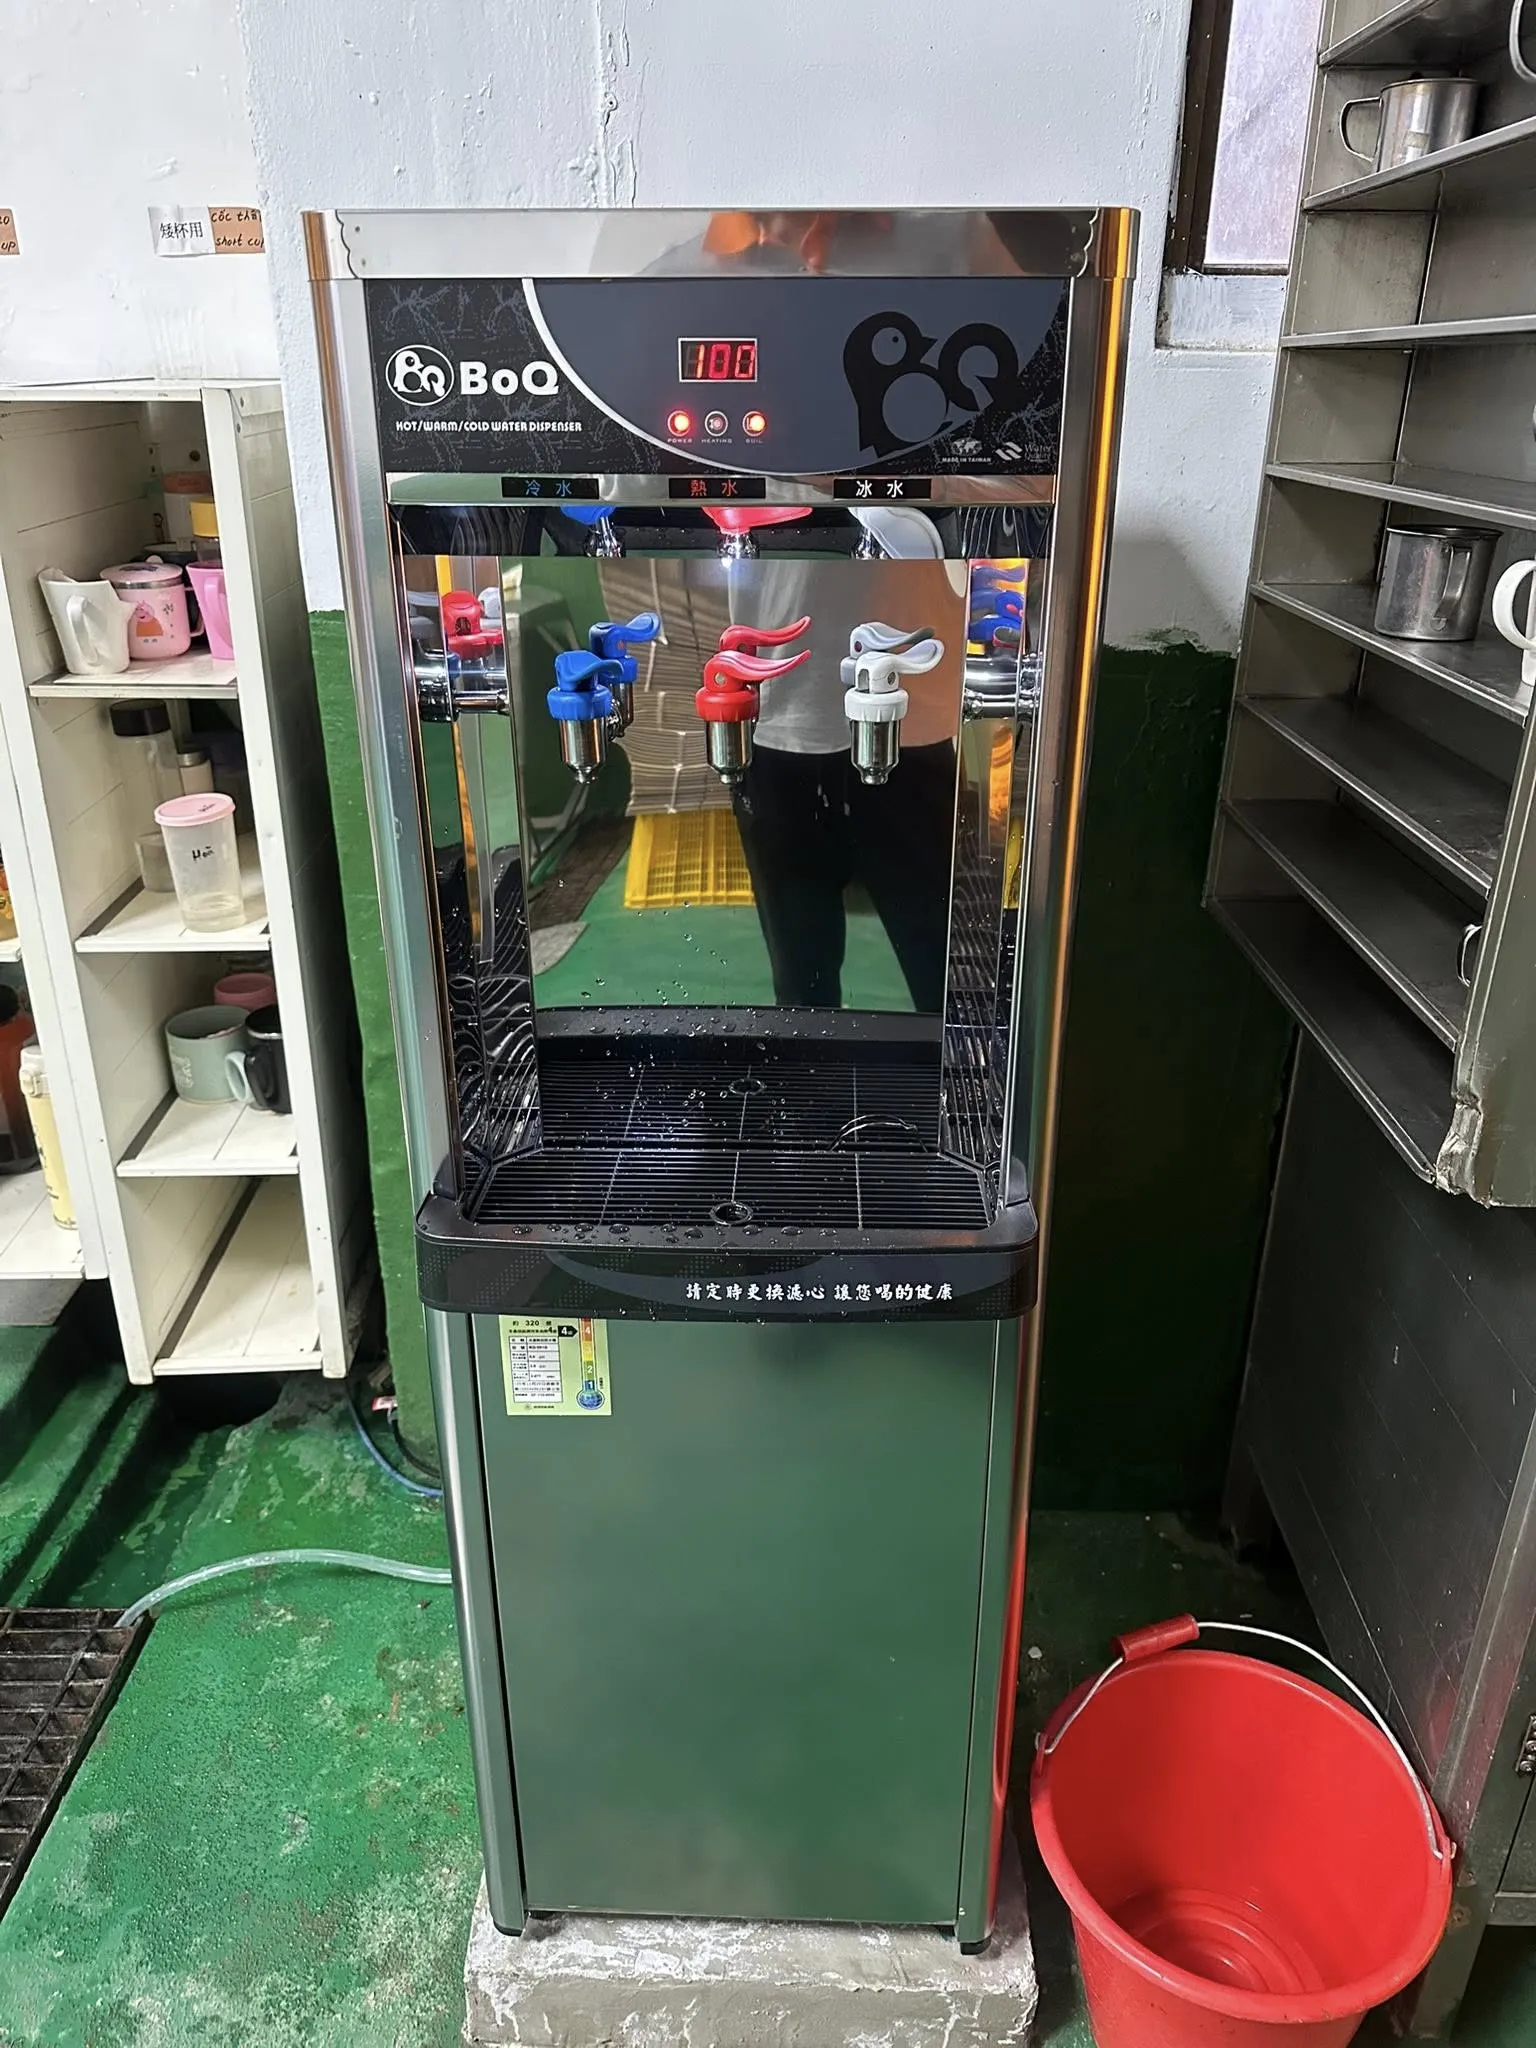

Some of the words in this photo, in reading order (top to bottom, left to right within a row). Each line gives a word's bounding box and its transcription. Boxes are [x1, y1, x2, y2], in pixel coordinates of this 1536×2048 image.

[159, 221, 204, 239] 矮杯用
[216, 233, 243, 247] short
[695, 343, 756, 379] 100
[459, 361, 560, 397] BoQ
[396, 420, 490, 433] HOT/WARM/COLD
[491, 421, 528, 433] WATER
[529, 421, 583, 433] DISPENSER
[525, 479, 573, 497] 冷水
[689, 479, 739, 497] 熱水
[855, 479, 904, 497] 冰水
[685, 1283, 826, 1301] 請定時更換濾心
[834, 1283, 954, 1301] 讓您喝的健康
[587, 1365, 593, 1374] 2
